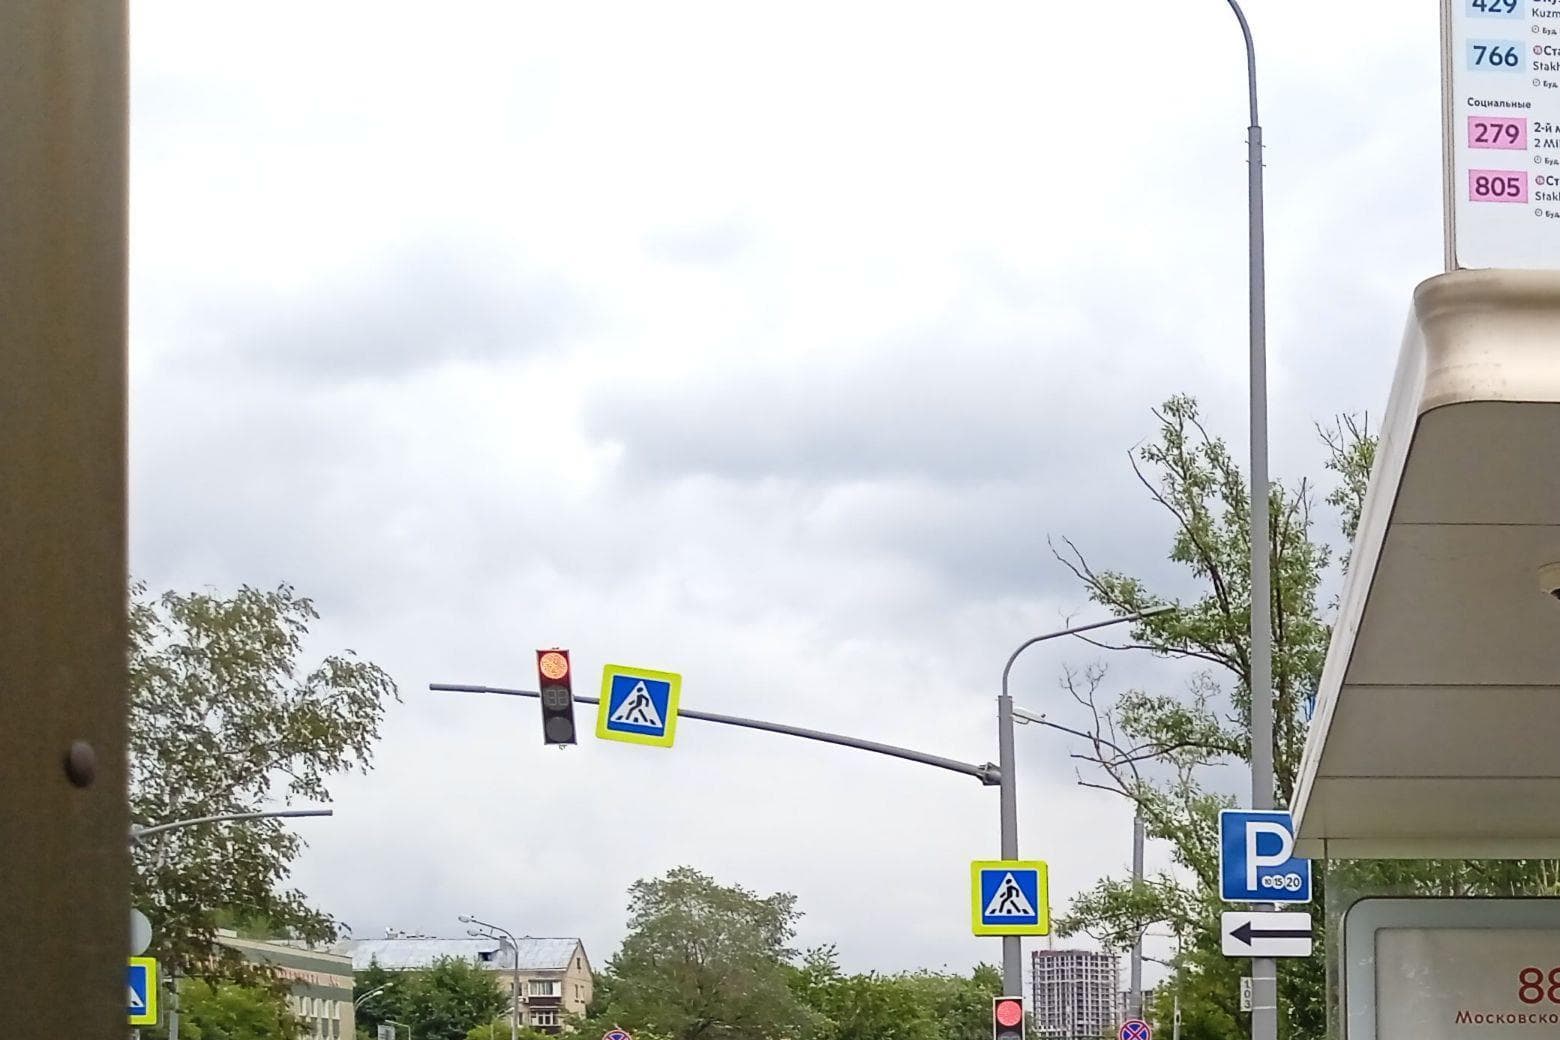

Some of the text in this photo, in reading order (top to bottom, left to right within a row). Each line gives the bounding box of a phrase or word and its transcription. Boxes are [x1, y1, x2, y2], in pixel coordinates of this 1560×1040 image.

[1472, 0, 1518, 14] 429
[1473, 45, 1519, 67] 766
[1467, 97, 1532, 109] Социальные
[1474, 122, 1520, 144] 279
[1534, 122, 1552, 133] 2-й
[1534, 139, 1541, 148] 2
[1475, 176, 1521, 198] 805
[1245, 821, 1295, 891] P
[1286, 876, 1301, 889] 20
